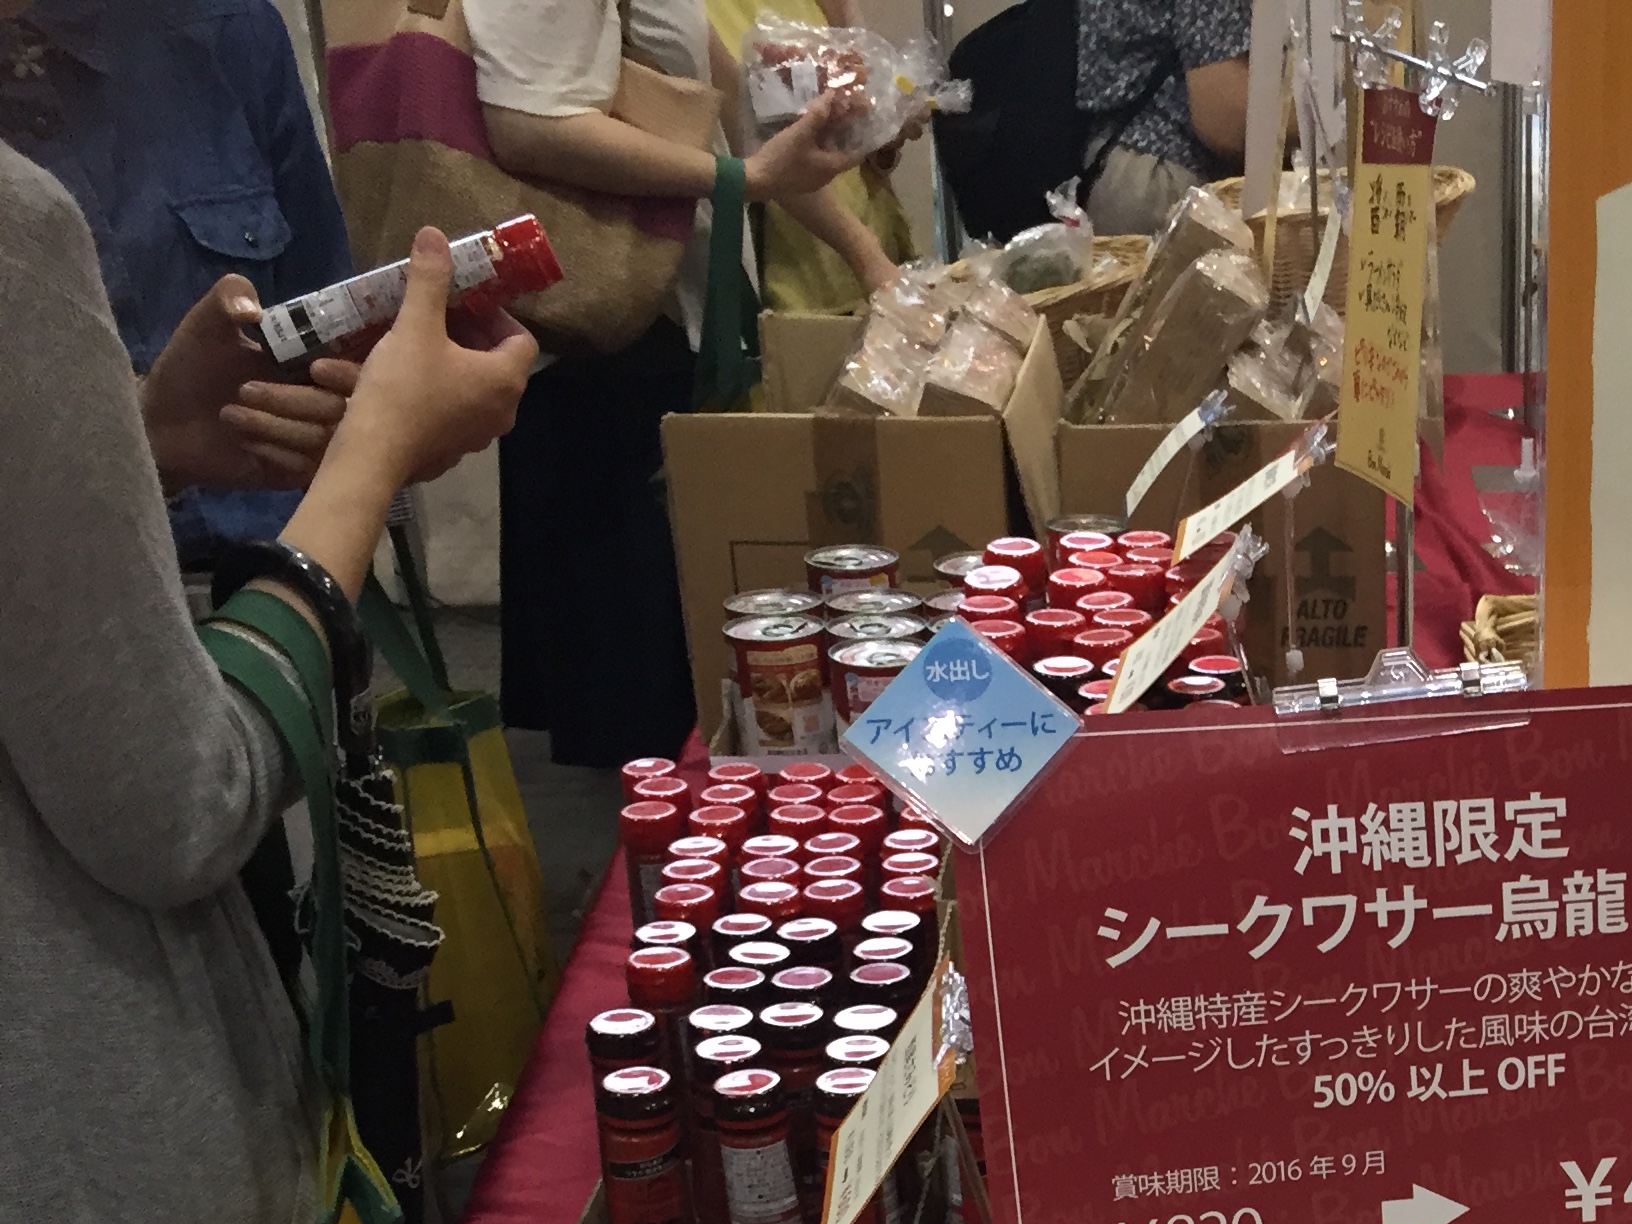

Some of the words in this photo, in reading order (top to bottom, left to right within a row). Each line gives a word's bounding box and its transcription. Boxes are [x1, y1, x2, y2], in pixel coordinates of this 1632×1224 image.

[1297, 599, 1348, 620] ALTO
[926, 659, 991, 683] 水出し
[866, 711, 1057, 745] アイティーに
[1288, 793, 1571, 878] 沖縄限定
[1096, 868, 1630, 968] シークワサー烏龍
